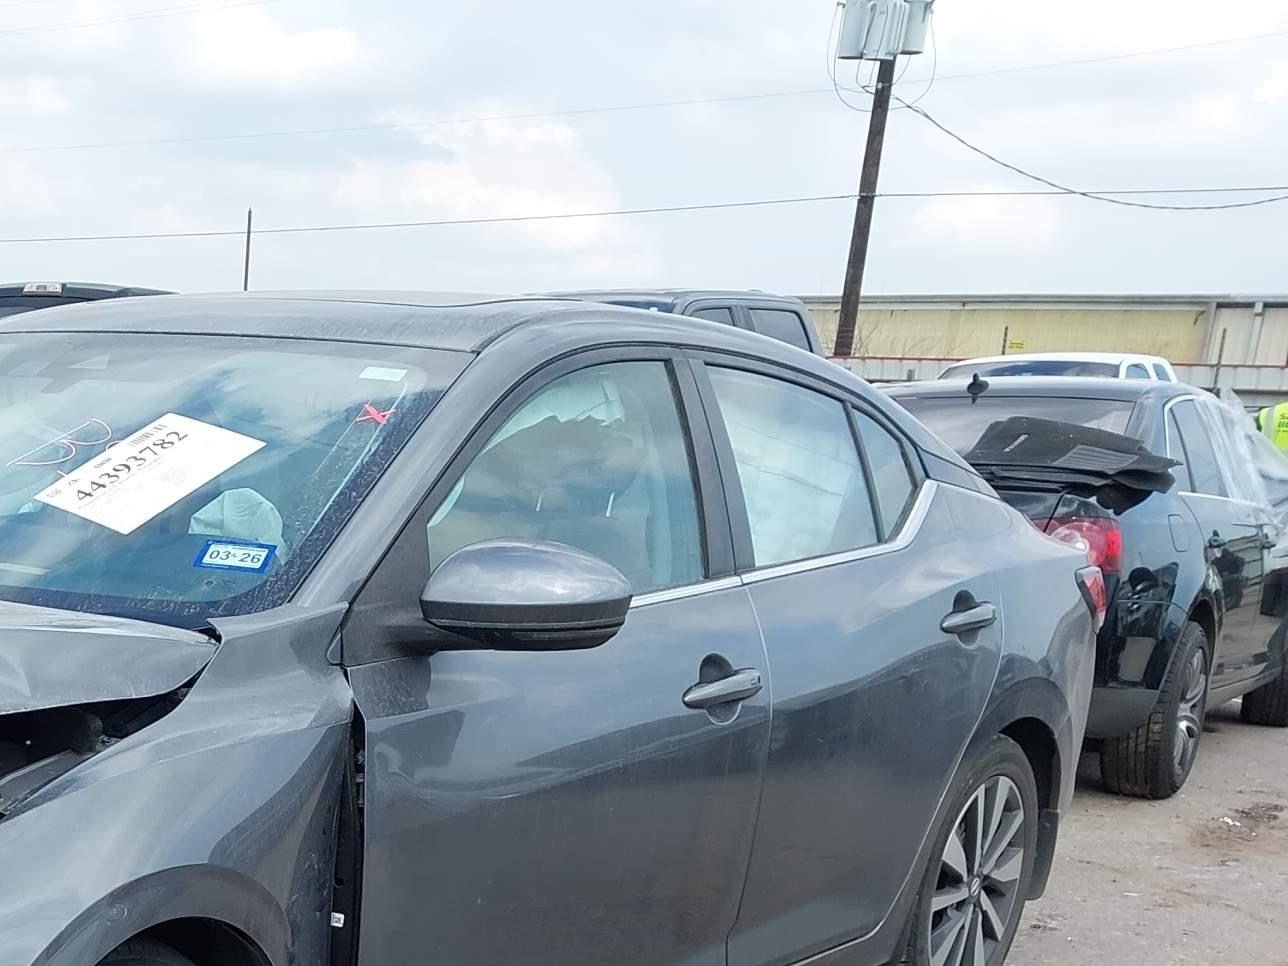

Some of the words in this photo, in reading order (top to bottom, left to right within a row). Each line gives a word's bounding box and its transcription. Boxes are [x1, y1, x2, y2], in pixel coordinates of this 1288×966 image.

[76, 430, 189, 502] 44393782
[208, 549, 232, 561] 03
[238, 552, 263, 564] 26
